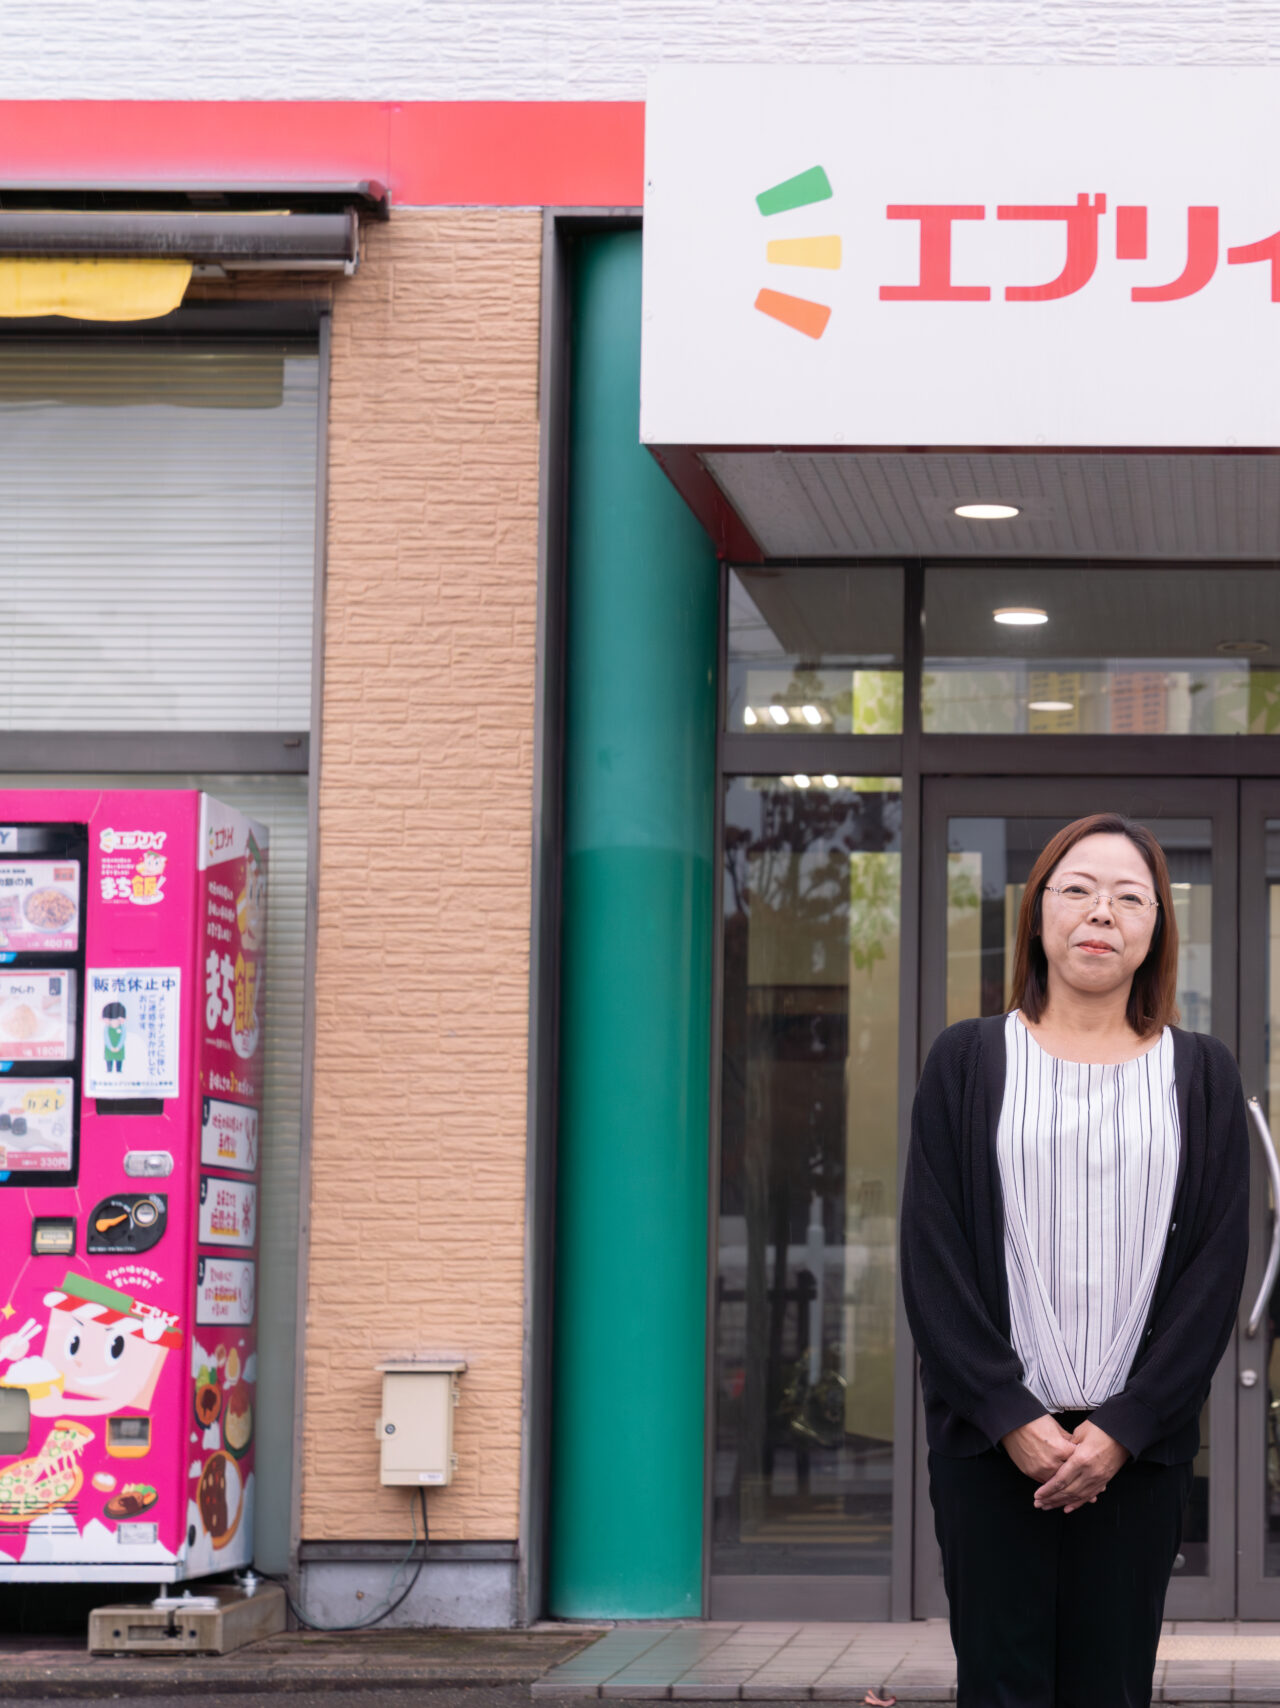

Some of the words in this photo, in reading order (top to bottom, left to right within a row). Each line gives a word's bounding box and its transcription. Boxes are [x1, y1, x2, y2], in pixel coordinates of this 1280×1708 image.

[94, 977, 176, 993] 販売休止中
